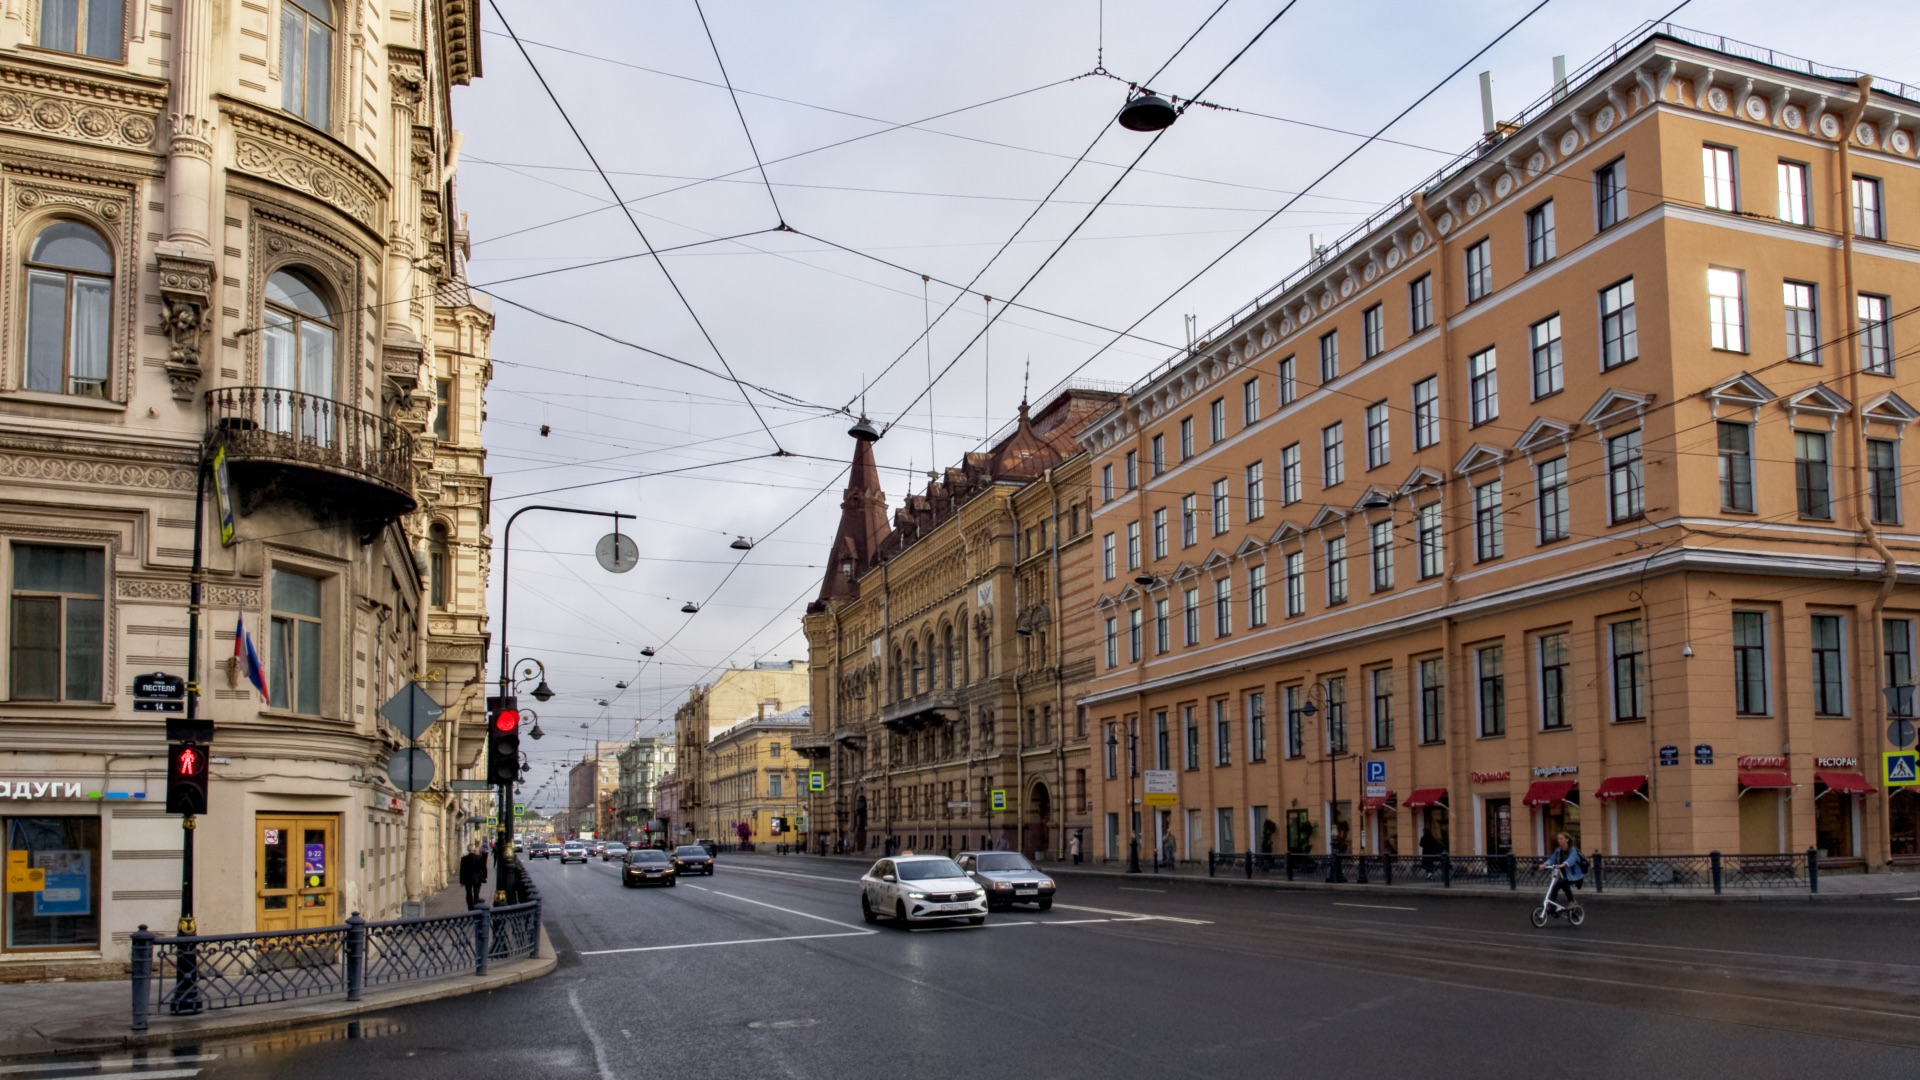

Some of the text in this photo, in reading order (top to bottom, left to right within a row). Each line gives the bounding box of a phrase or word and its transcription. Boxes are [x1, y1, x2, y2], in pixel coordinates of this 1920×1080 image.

[142, 684, 176, 692] ПЕСТЕЛЯ
[1818, 757, 1857, 767] РЕСТОРАН
[0, 781, 81, 800] адуги
